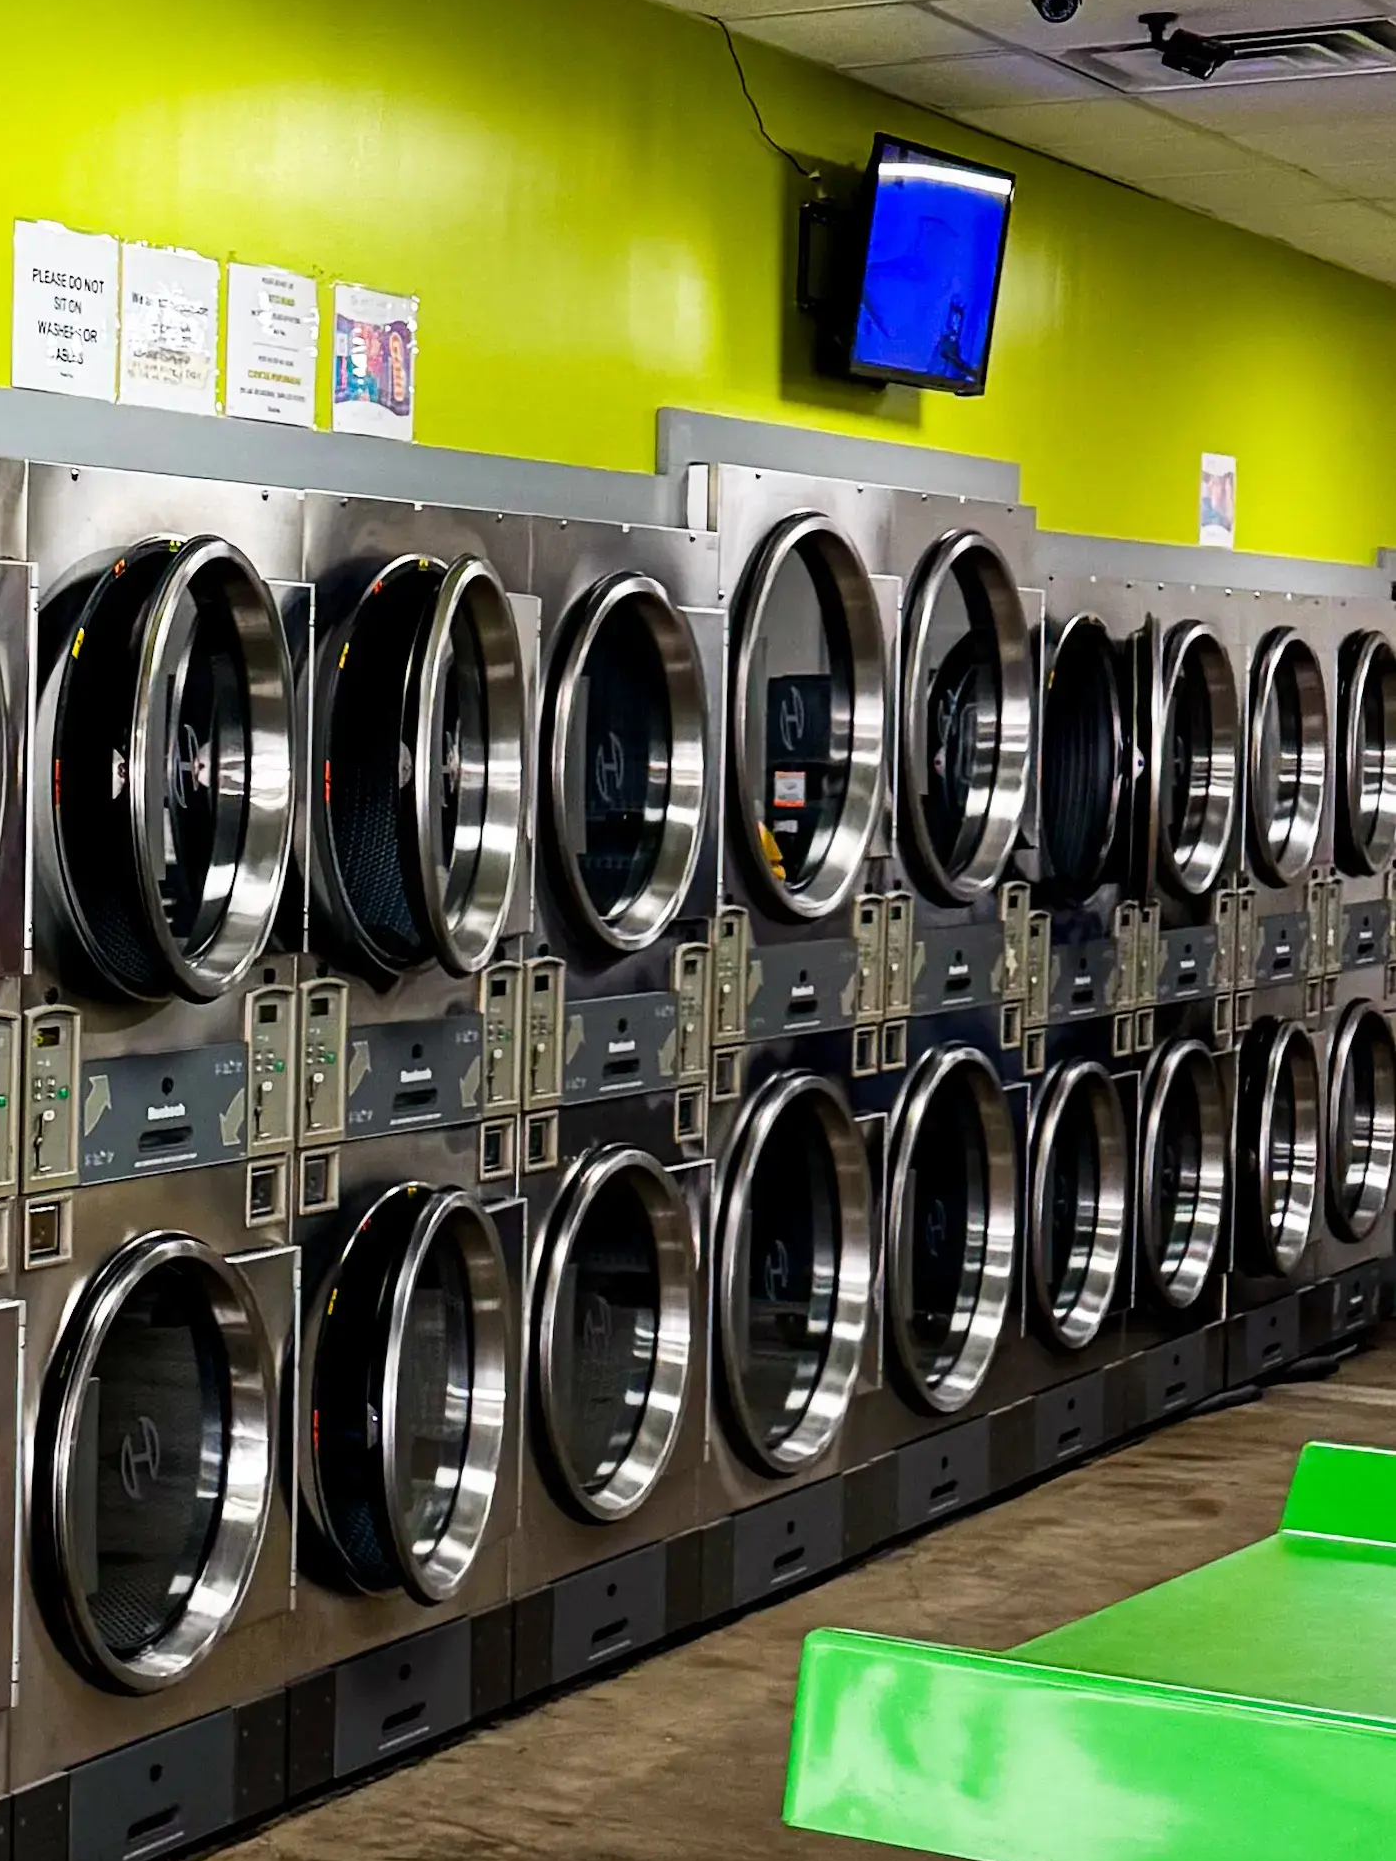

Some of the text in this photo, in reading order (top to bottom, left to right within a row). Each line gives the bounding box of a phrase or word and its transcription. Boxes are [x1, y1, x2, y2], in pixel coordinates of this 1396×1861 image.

[32, 267, 66, 288] PLEASE
[84, 278, 105, 294] NOT
[54, 296, 67, 311] SIT
[83, 328, 97, 343] OR
